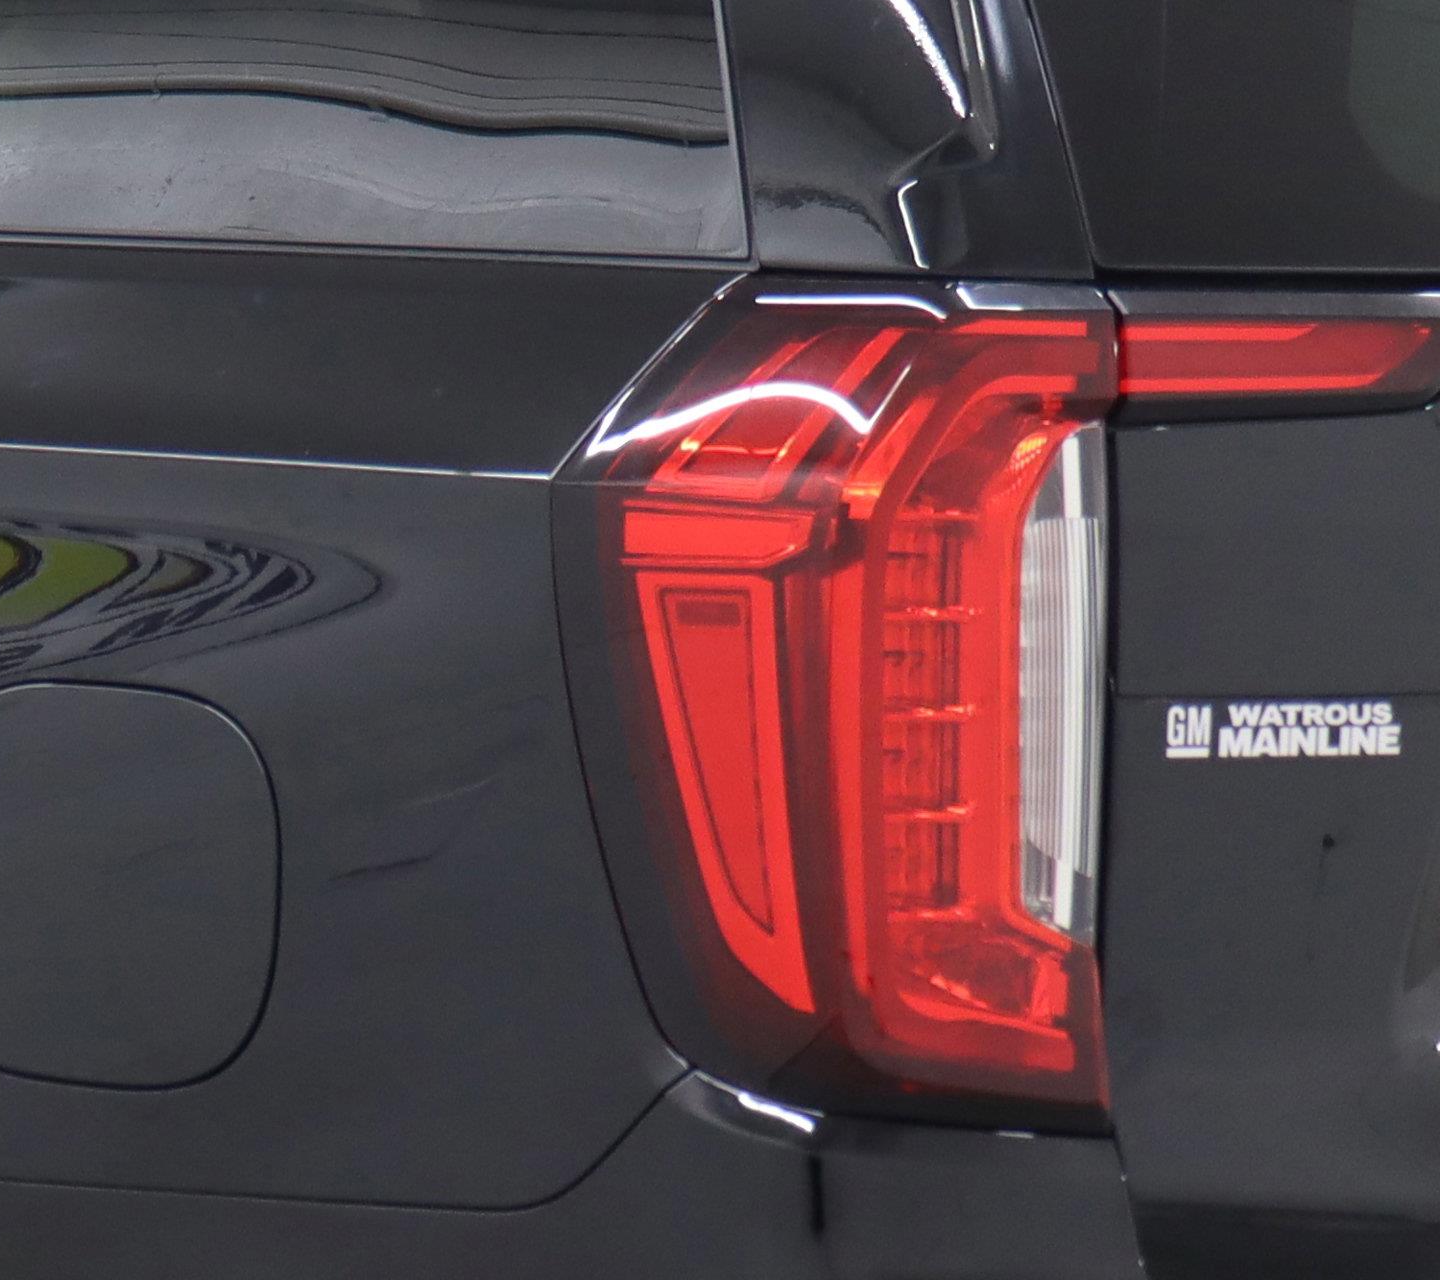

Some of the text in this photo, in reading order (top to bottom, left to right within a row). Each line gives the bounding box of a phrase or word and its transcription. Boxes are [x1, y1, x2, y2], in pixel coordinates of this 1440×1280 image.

[1166, 704, 1212, 750] GM
[1227, 701, 1394, 727] WATROUS
[1218, 724, 1401, 758] MAINLINE
